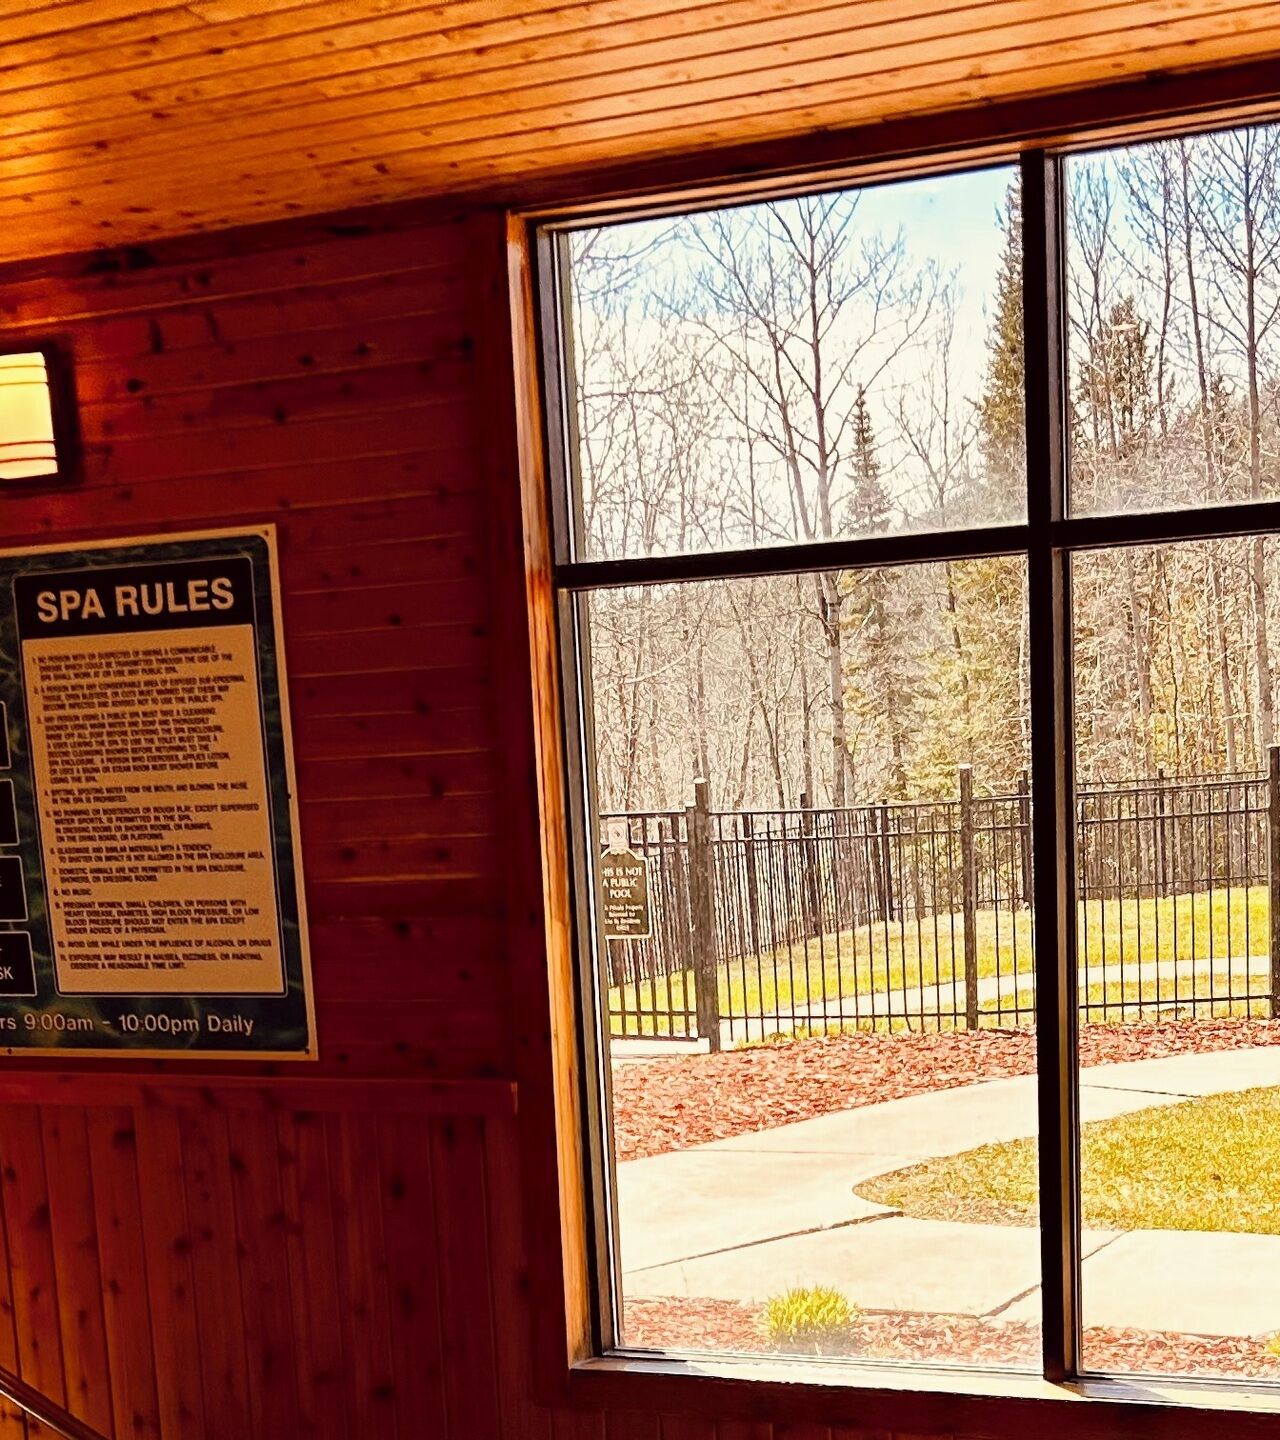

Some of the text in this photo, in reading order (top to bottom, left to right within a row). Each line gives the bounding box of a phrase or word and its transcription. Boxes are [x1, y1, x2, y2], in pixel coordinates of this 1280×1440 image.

[37, 577, 234, 622] SPA RULES
[609, 888, 632, 898] POOL
[24, 1013, 93, 1031] 9:00am
[119, 1014, 199, 1035] 10:00pm
[207, 1015, 253, 1036] Daily
